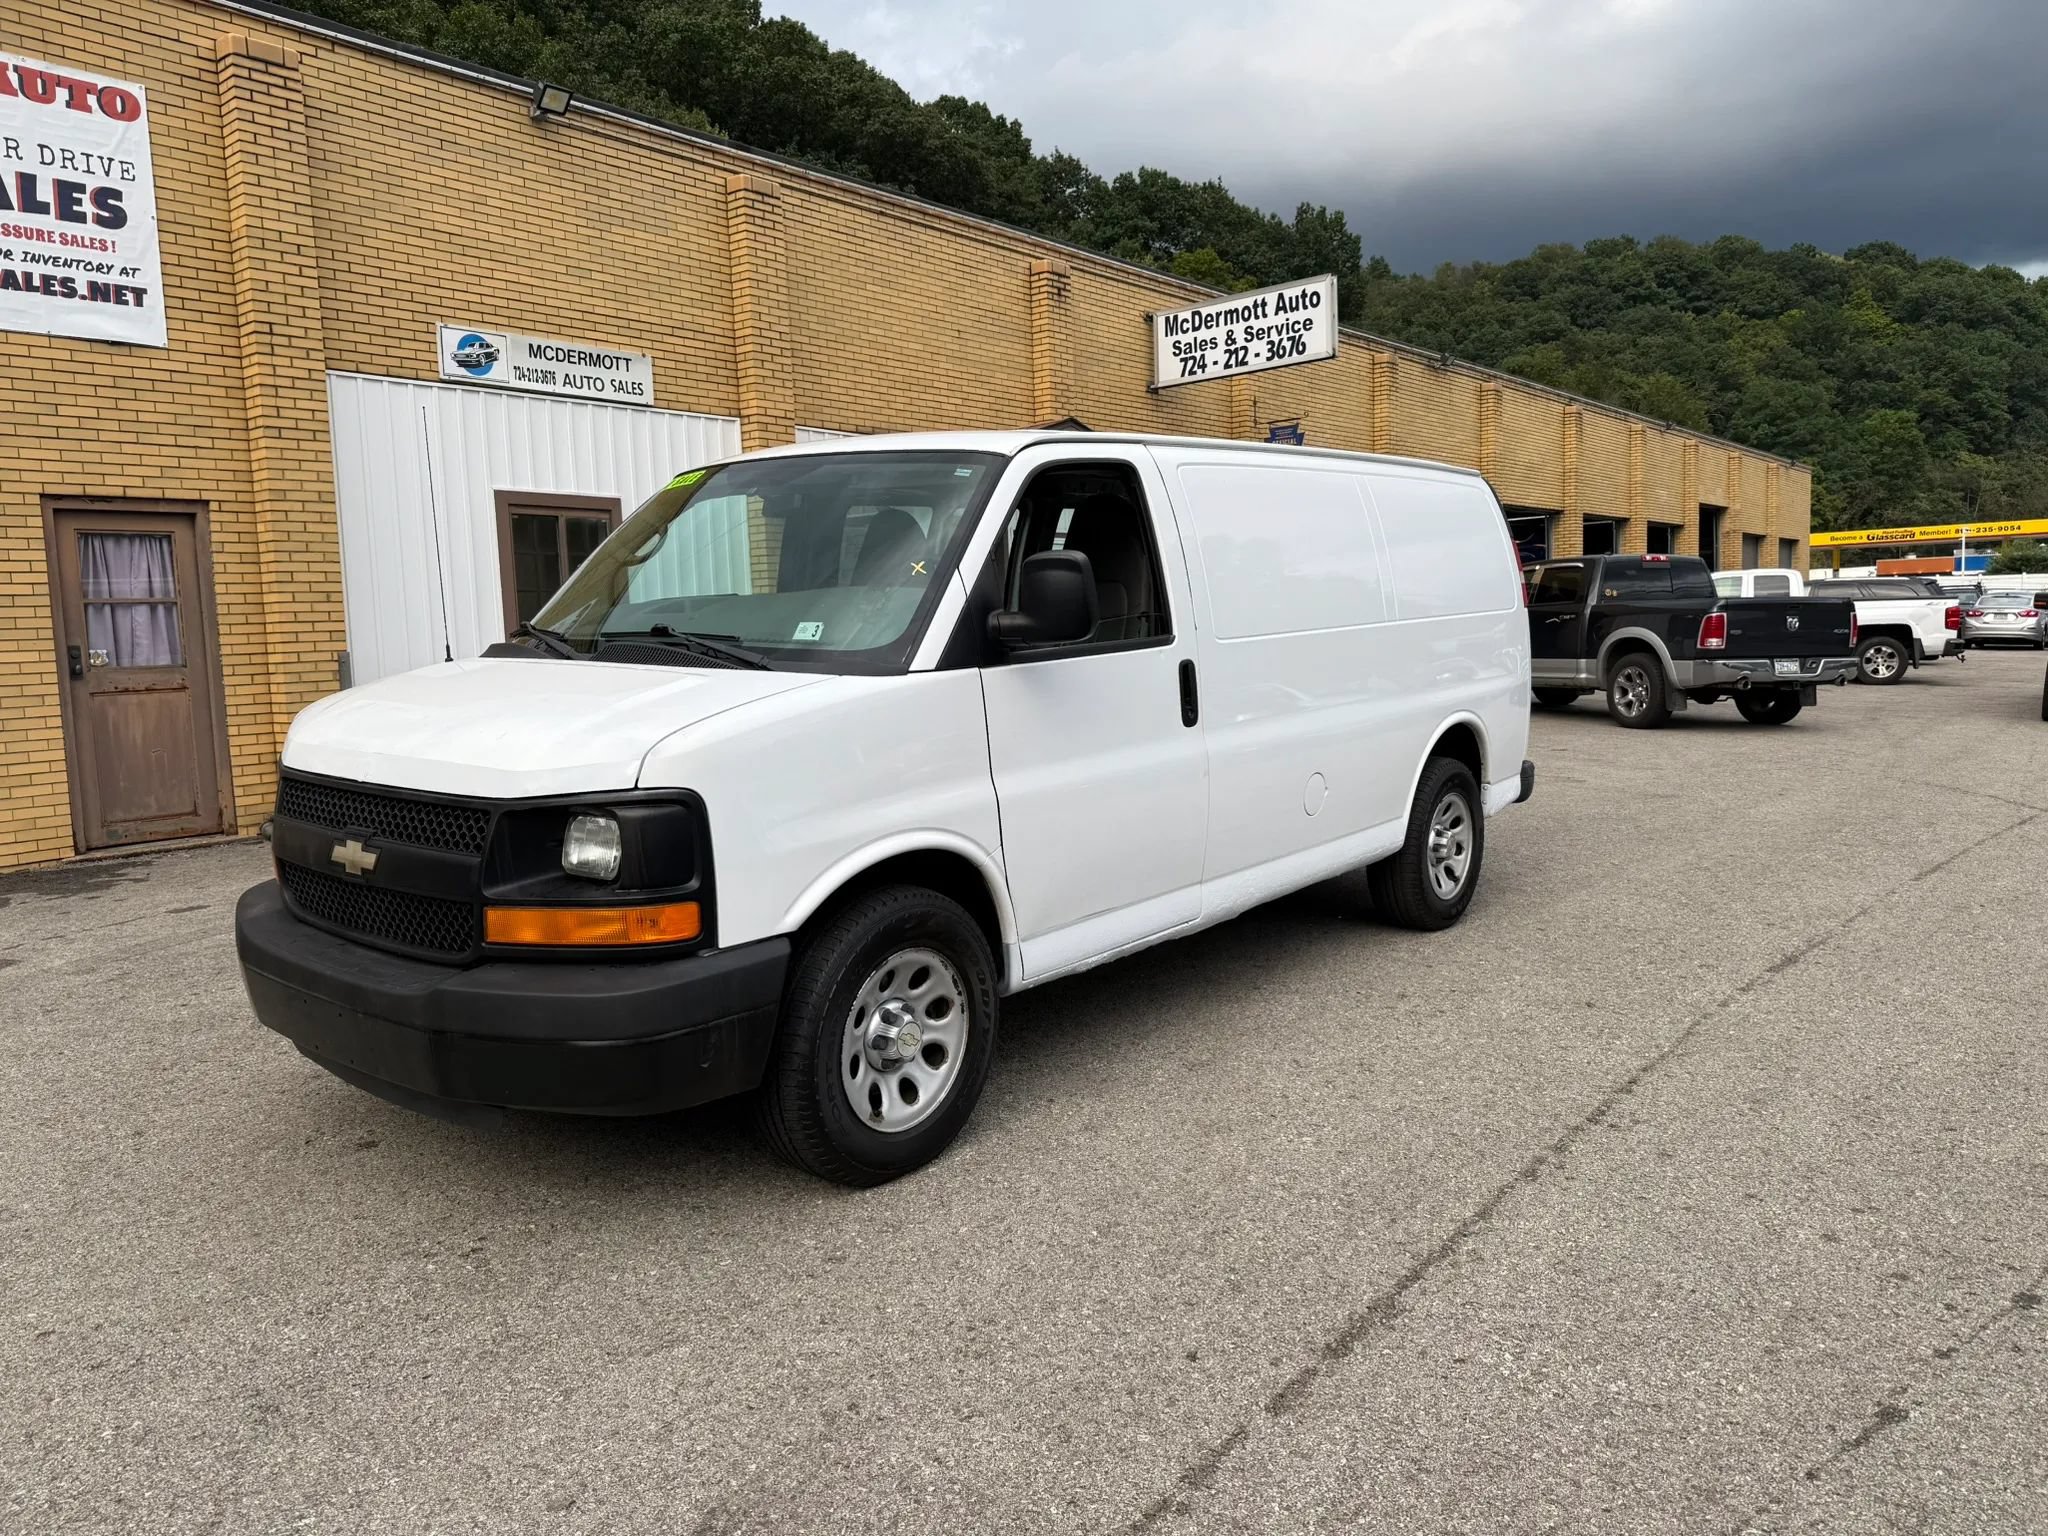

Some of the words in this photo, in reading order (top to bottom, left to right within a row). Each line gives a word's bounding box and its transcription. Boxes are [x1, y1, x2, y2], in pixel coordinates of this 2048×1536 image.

[36, 143, 136, 182] DRIVE
[20, 250, 114, 275] INVENTORY
[119, 265, 142, 279] AT
[1164, 296, 1268, 338] McDermott
[1274, 287, 1321, 316] Auto
[1172, 336, 1218, 357] Sales
[1224, 329, 1237, 347] &
[1243, 317, 1314, 343] Service
[528, 343, 633, 373] MCDERMOTT
[513, 365, 557, 386] 724-212-3676
[562, 373, 605, 392] AUTO
[610, 378, 644, 396] SALES
[1866, 532, 1916, 541] Glasscard
[1919, 529, 1951, 537] Member!
[1954, 525, 2021, 535] 8-235-9054
[811, 624, 820, 638] 3
